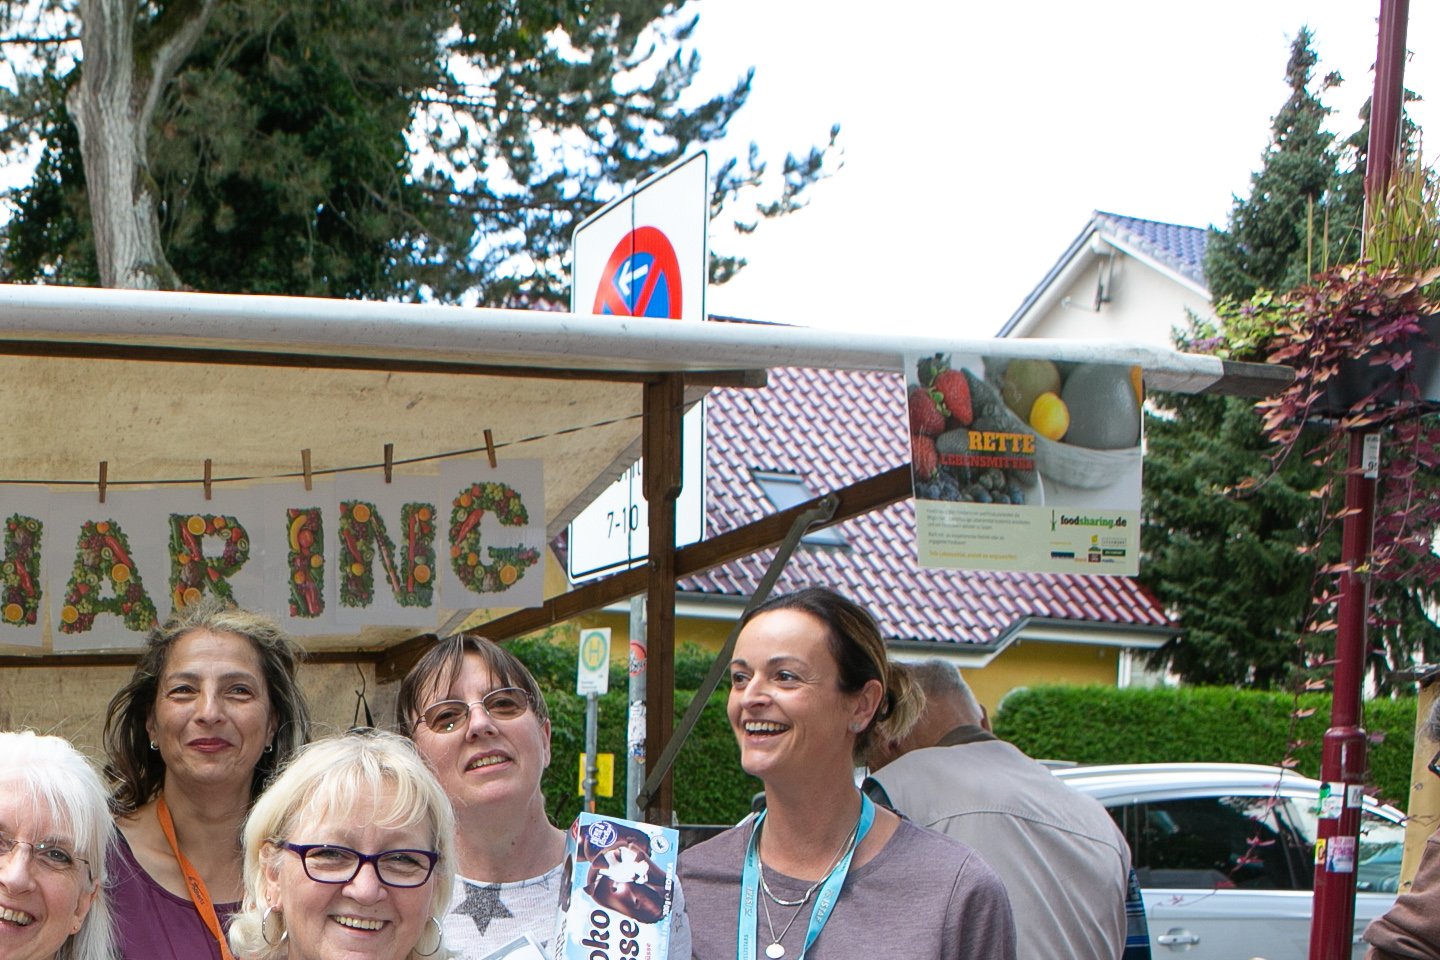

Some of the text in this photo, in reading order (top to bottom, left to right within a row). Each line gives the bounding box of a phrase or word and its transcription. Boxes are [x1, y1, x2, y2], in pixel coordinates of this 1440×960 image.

[968, 430, 1036, 454] RETTE
[606, 503, 639, 539] 7-10
[1060, 514, 1127, 529] foodsharing.de
